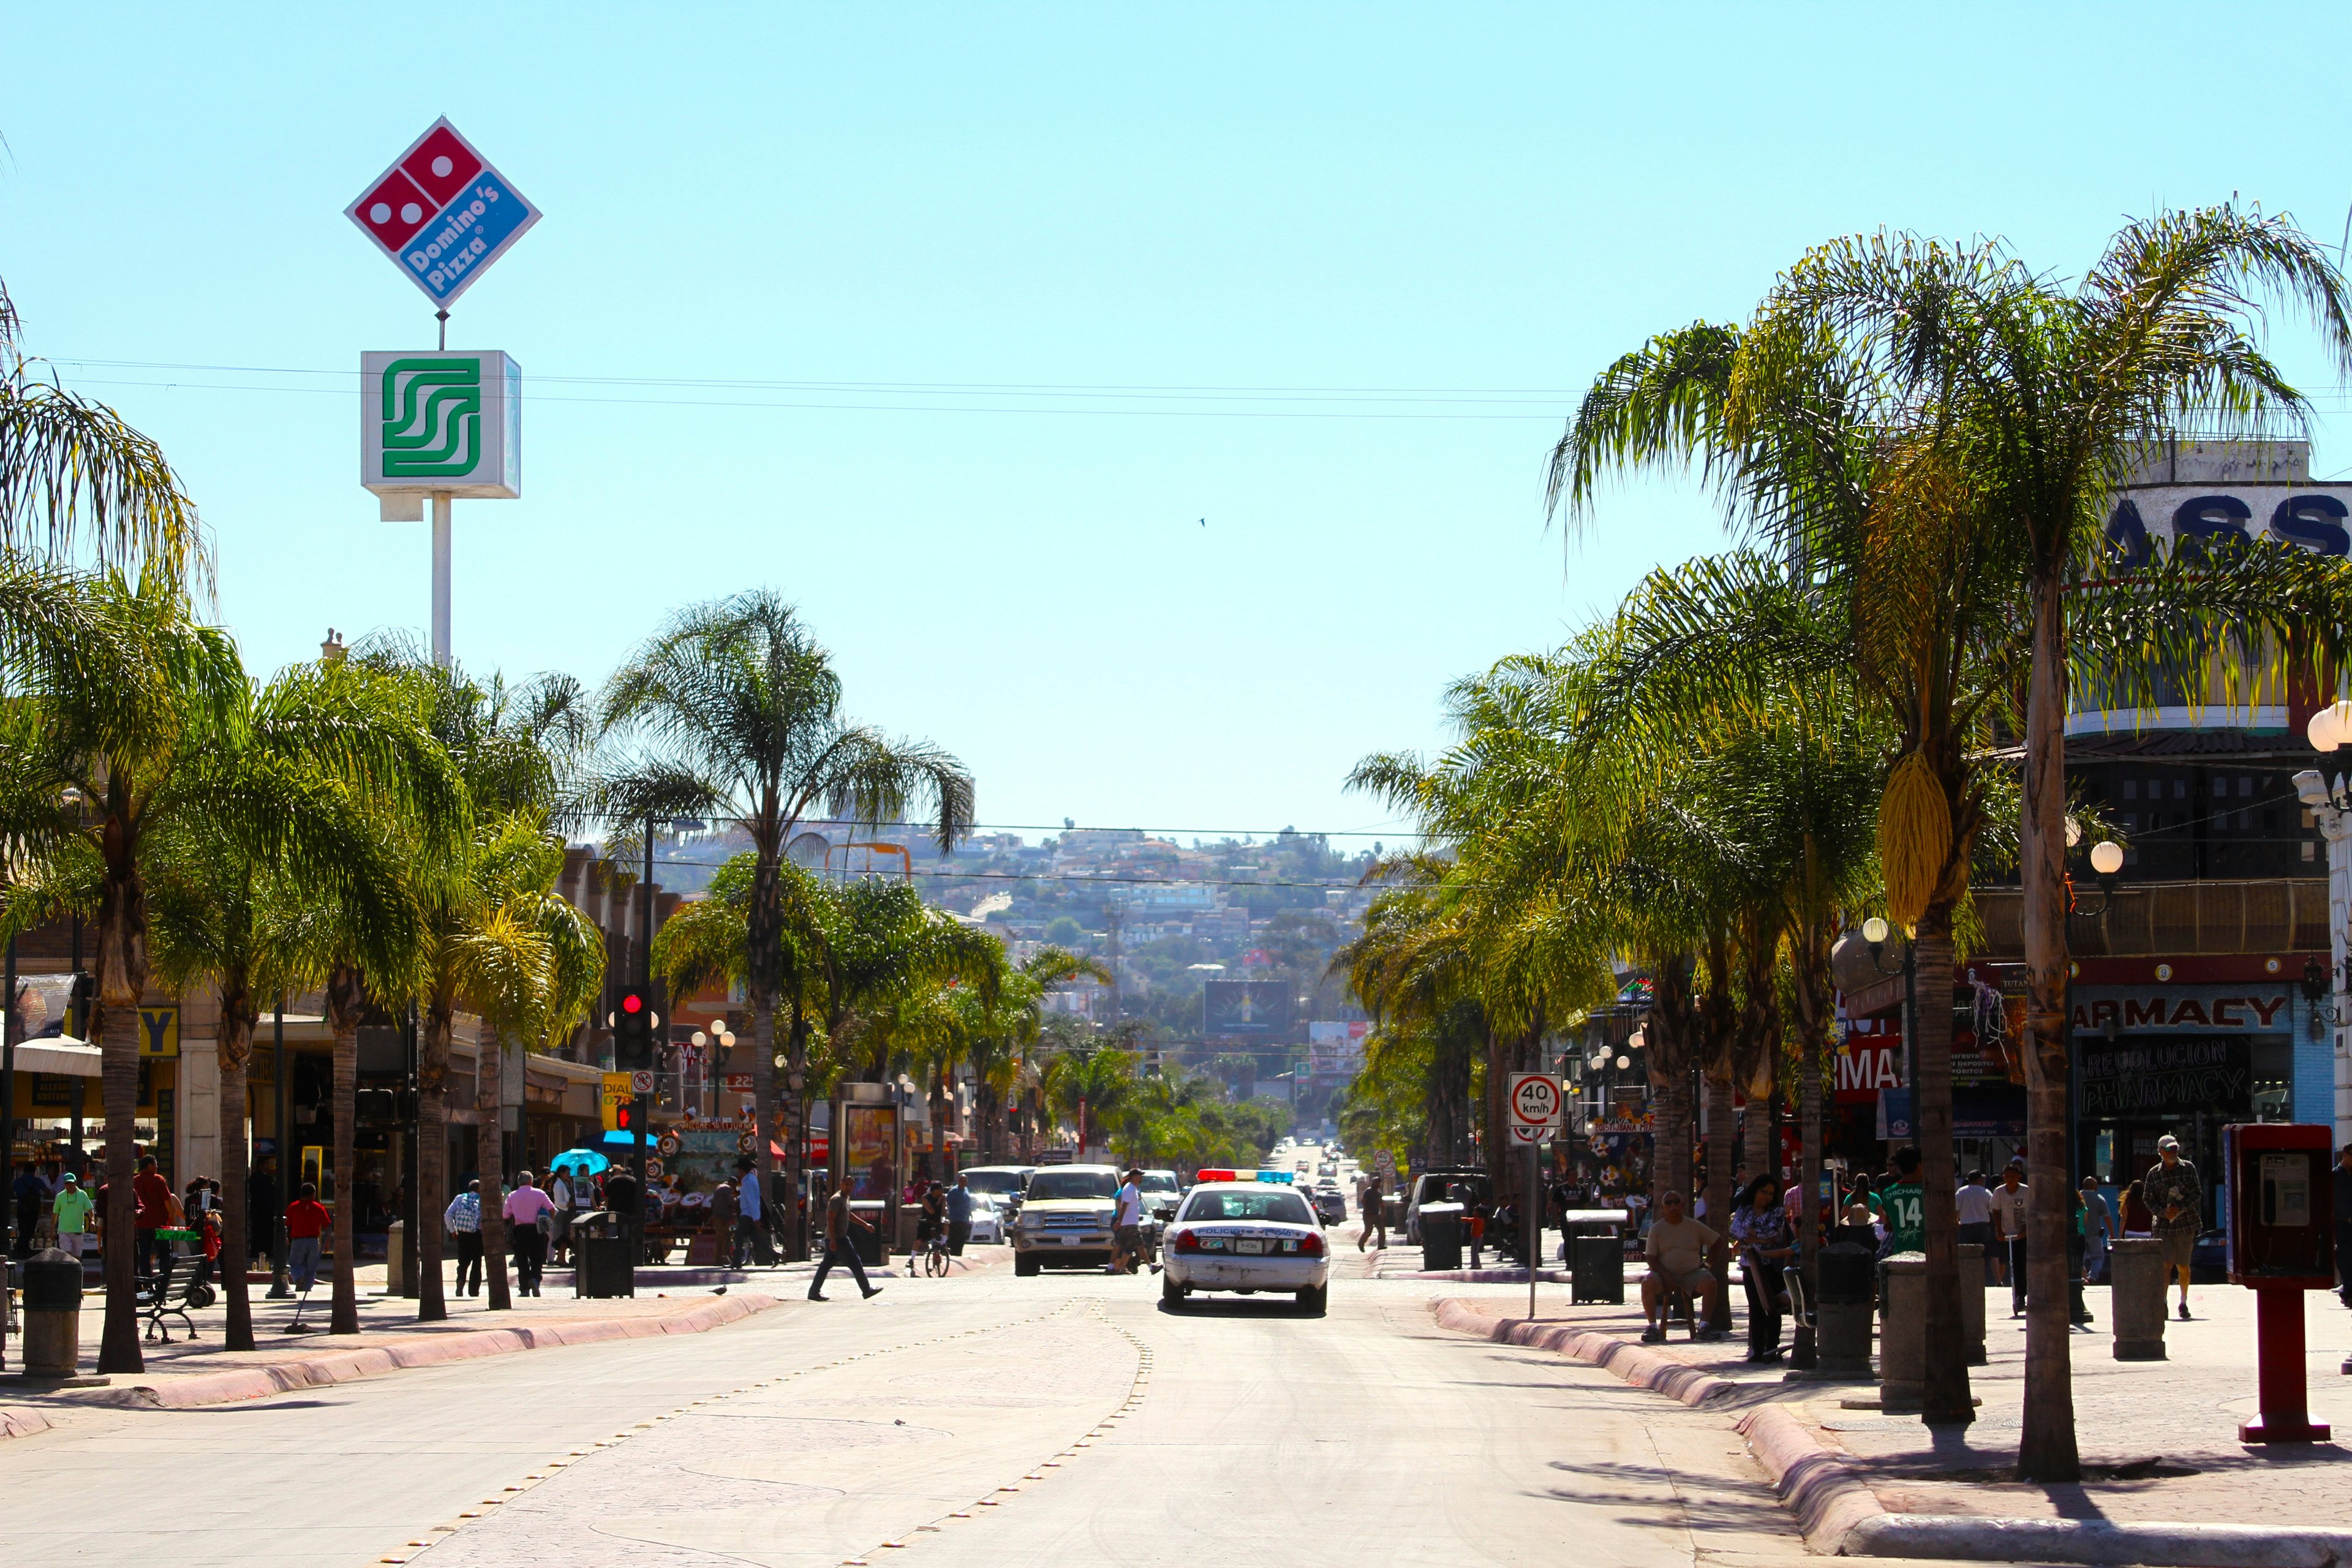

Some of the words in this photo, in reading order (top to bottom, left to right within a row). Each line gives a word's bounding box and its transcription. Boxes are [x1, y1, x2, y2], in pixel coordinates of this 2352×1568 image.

[407, 186, 499, 273] Domino's
[427, 237, 487, 292] Pizza
[2162, 968, 2168, 978] 9
[141, 1012, 173, 1052] Y
[2087, 1039, 2226, 1077] REVOLUCION
[603, 1084, 633, 1095] DIAL
[603, 1095, 632, 1106] 078
[1521, 1085, 1548, 1100] 40
[2083, 1069, 2245, 1114] PHARMACY
[1523, 1102, 1549, 1114] km/h
[1411, 1158, 1417, 1167] E
[1894, 1197, 1923, 1228] 14
